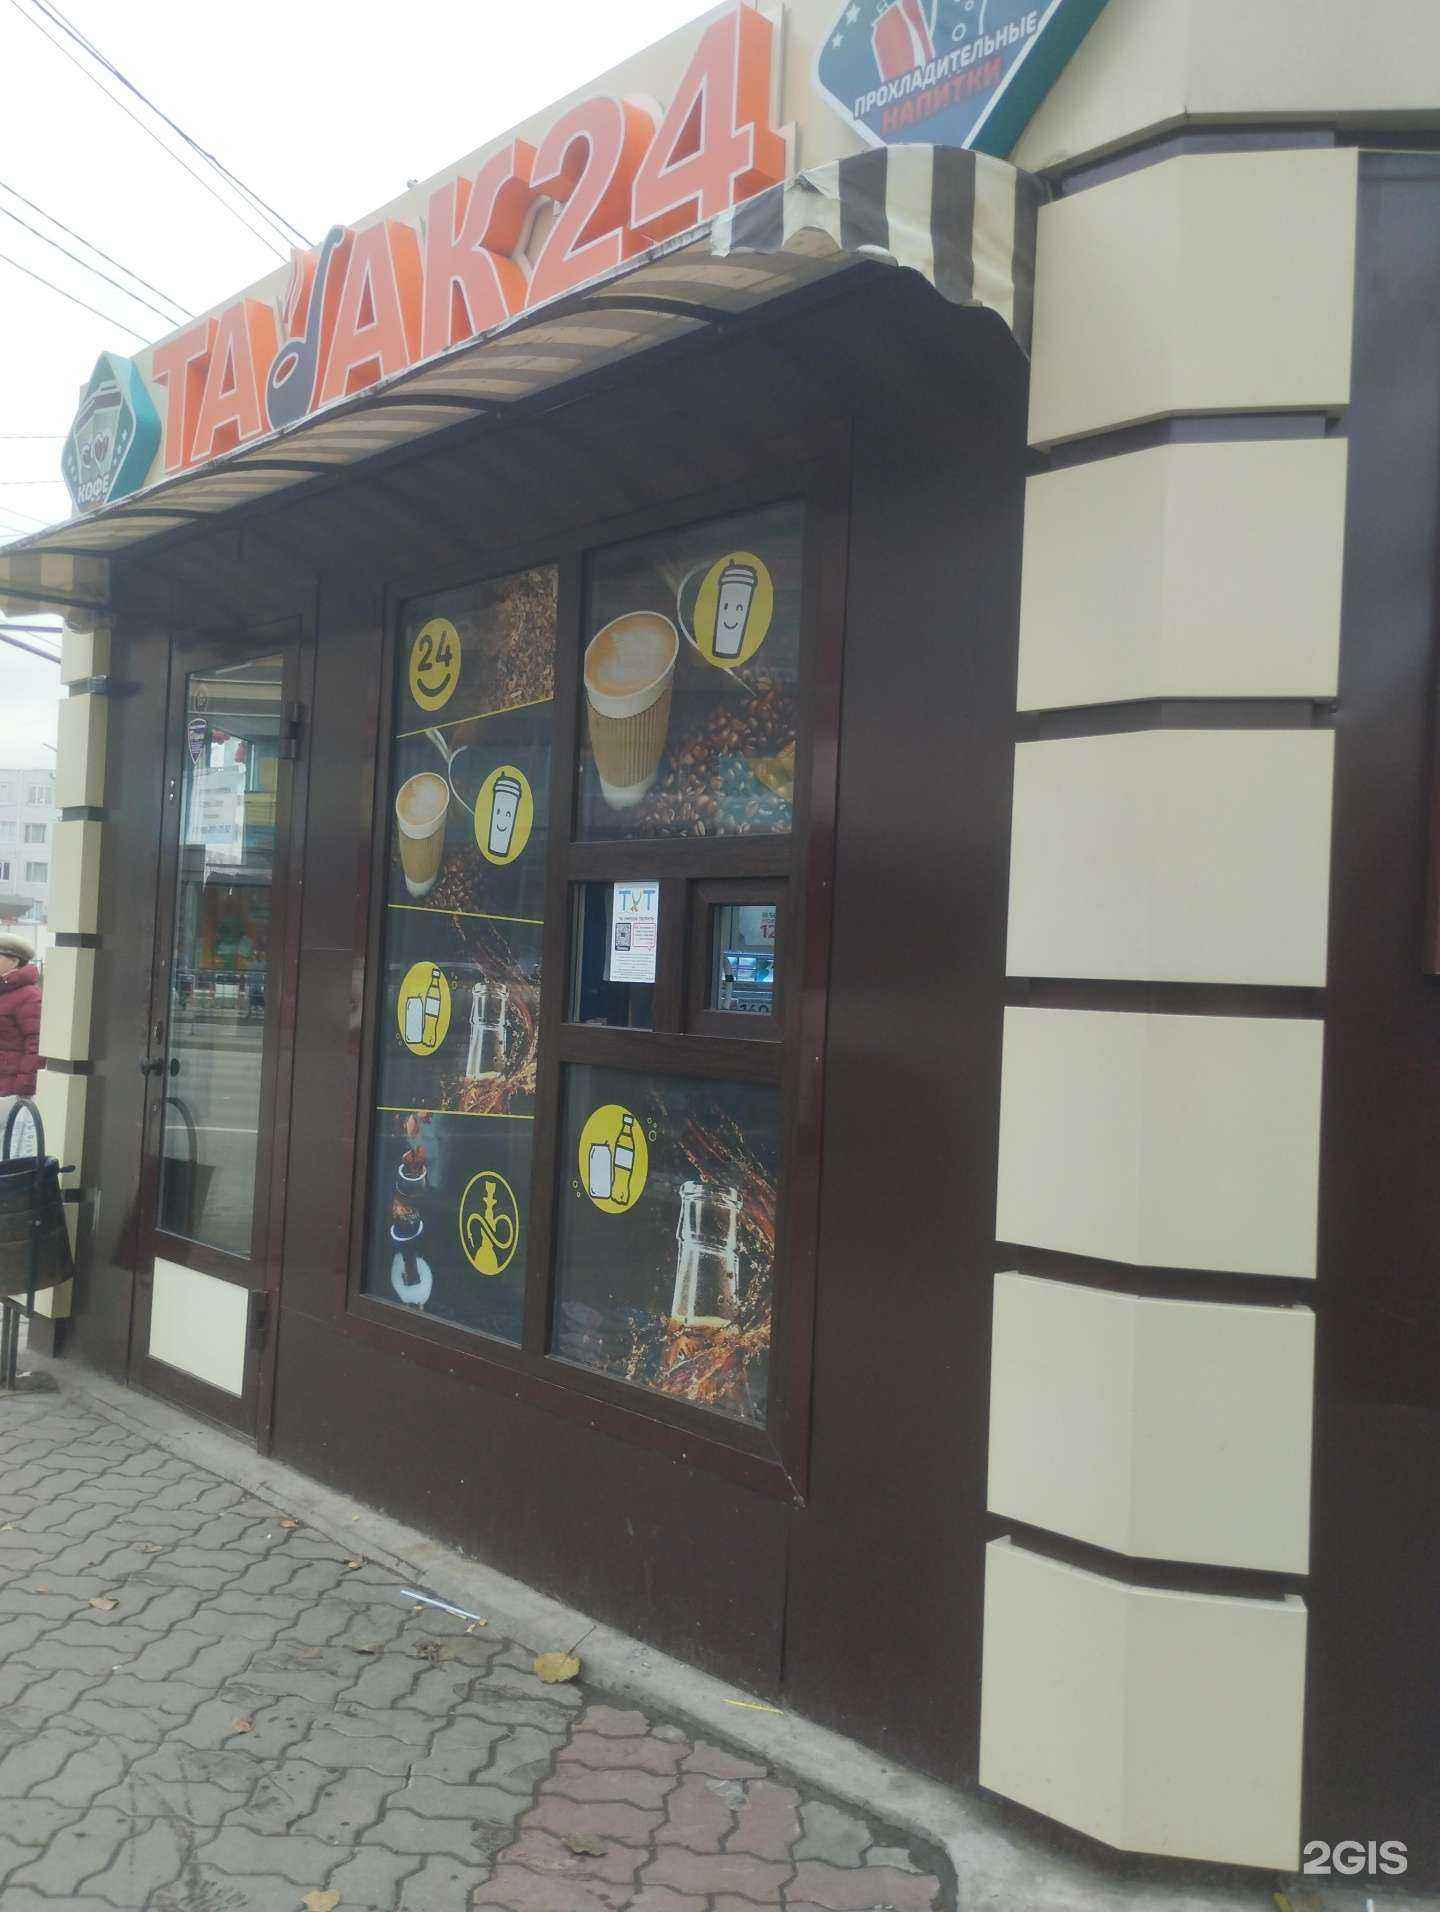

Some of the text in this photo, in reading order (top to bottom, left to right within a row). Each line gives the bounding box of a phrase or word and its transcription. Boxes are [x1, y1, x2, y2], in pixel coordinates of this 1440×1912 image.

[853, 10, 1038, 120] ПРОХЛАДИТЕЛЬНЫЕ
[881, 57, 1005, 134] НАПИТКИ
[78, 473, 111, 503] КОФЕ
[417, 630, 453, 672] 24
